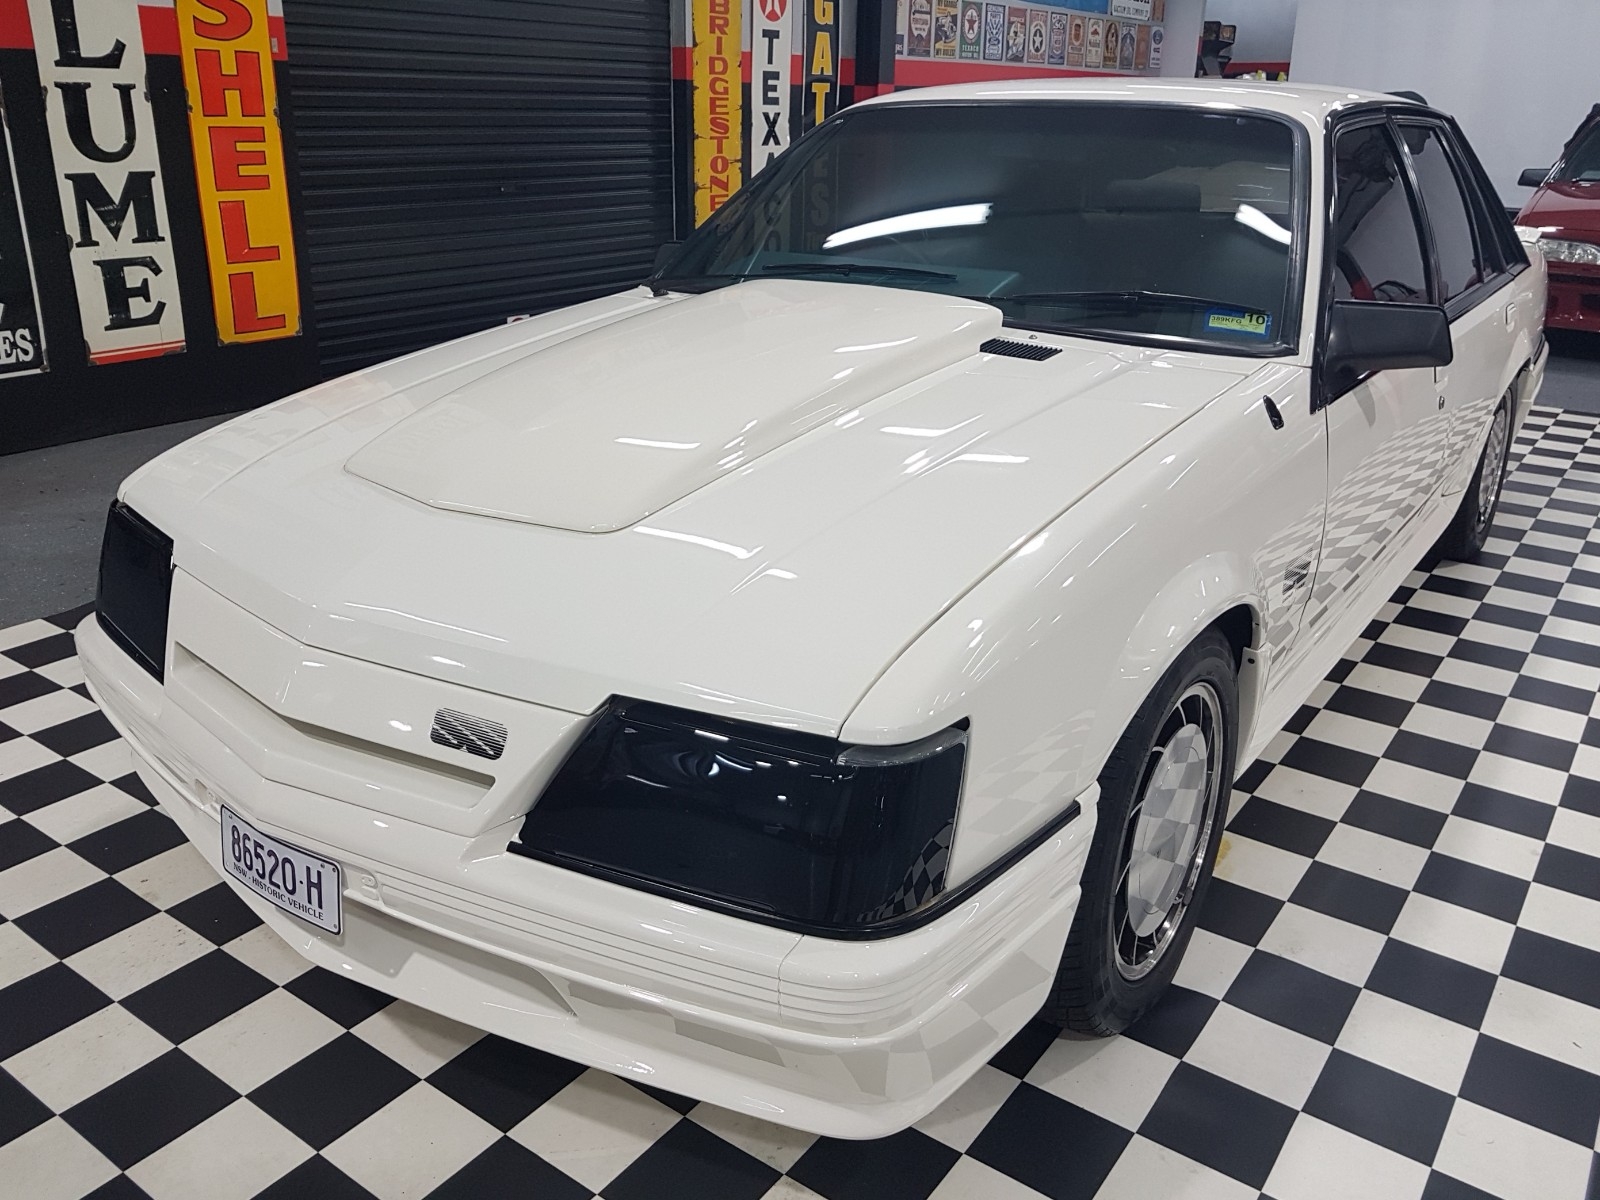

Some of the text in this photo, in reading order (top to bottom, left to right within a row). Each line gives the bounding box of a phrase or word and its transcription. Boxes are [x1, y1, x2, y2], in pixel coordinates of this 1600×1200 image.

[193, 0, 287, 335] SHELL
[709, 0, 730, 213] BRIDGESTONE
[1247, 313, 1266, 325] 10
[233, 862, 324, 921] NSW HISTORIC VEHICLE
